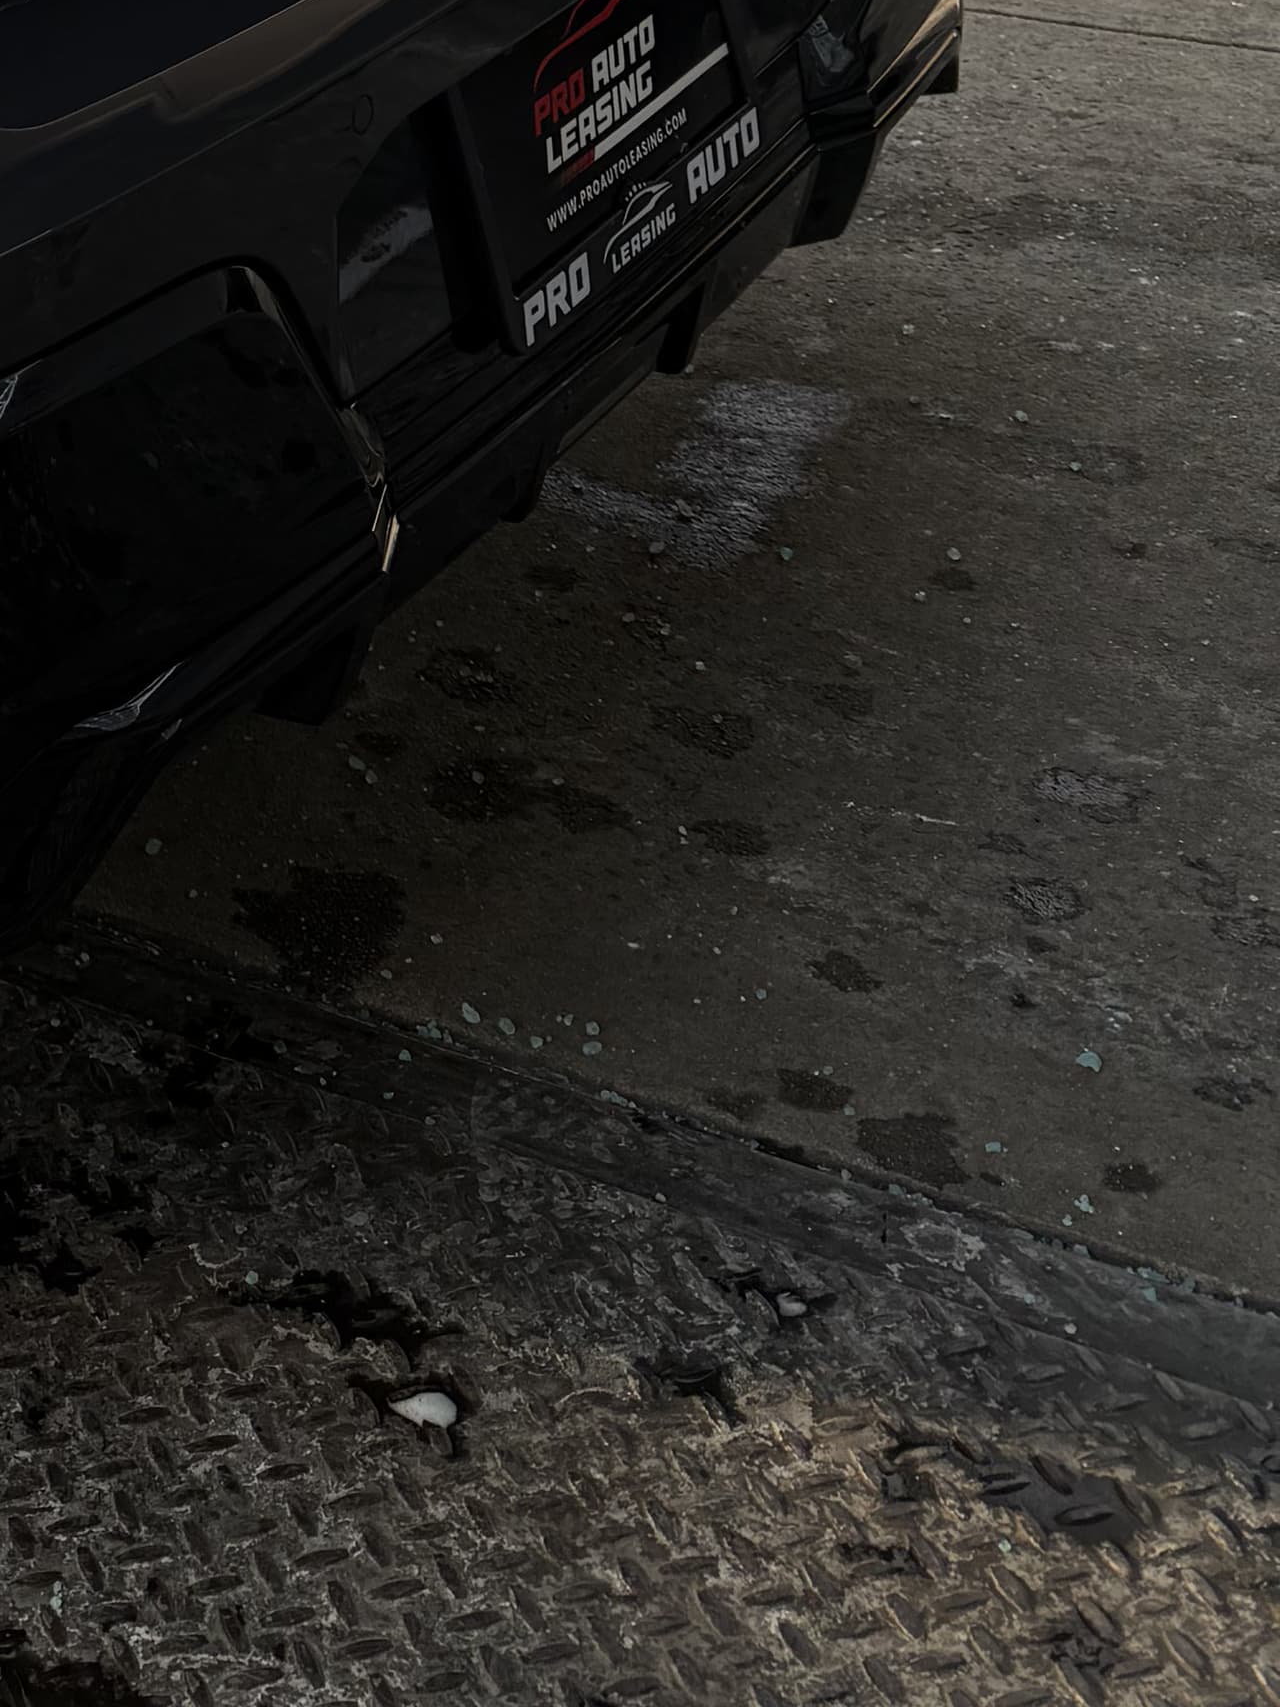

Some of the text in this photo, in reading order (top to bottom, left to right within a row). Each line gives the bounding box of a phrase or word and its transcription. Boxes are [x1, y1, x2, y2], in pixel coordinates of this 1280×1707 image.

[532, 14, 655, 138] PRO AUTO
[546, 59, 654, 175] LEASING
[523, 106, 760, 347] PRO LEASING AUTO
[546, 107, 687, 232] WWW.PROAUTOLEASING.COM
